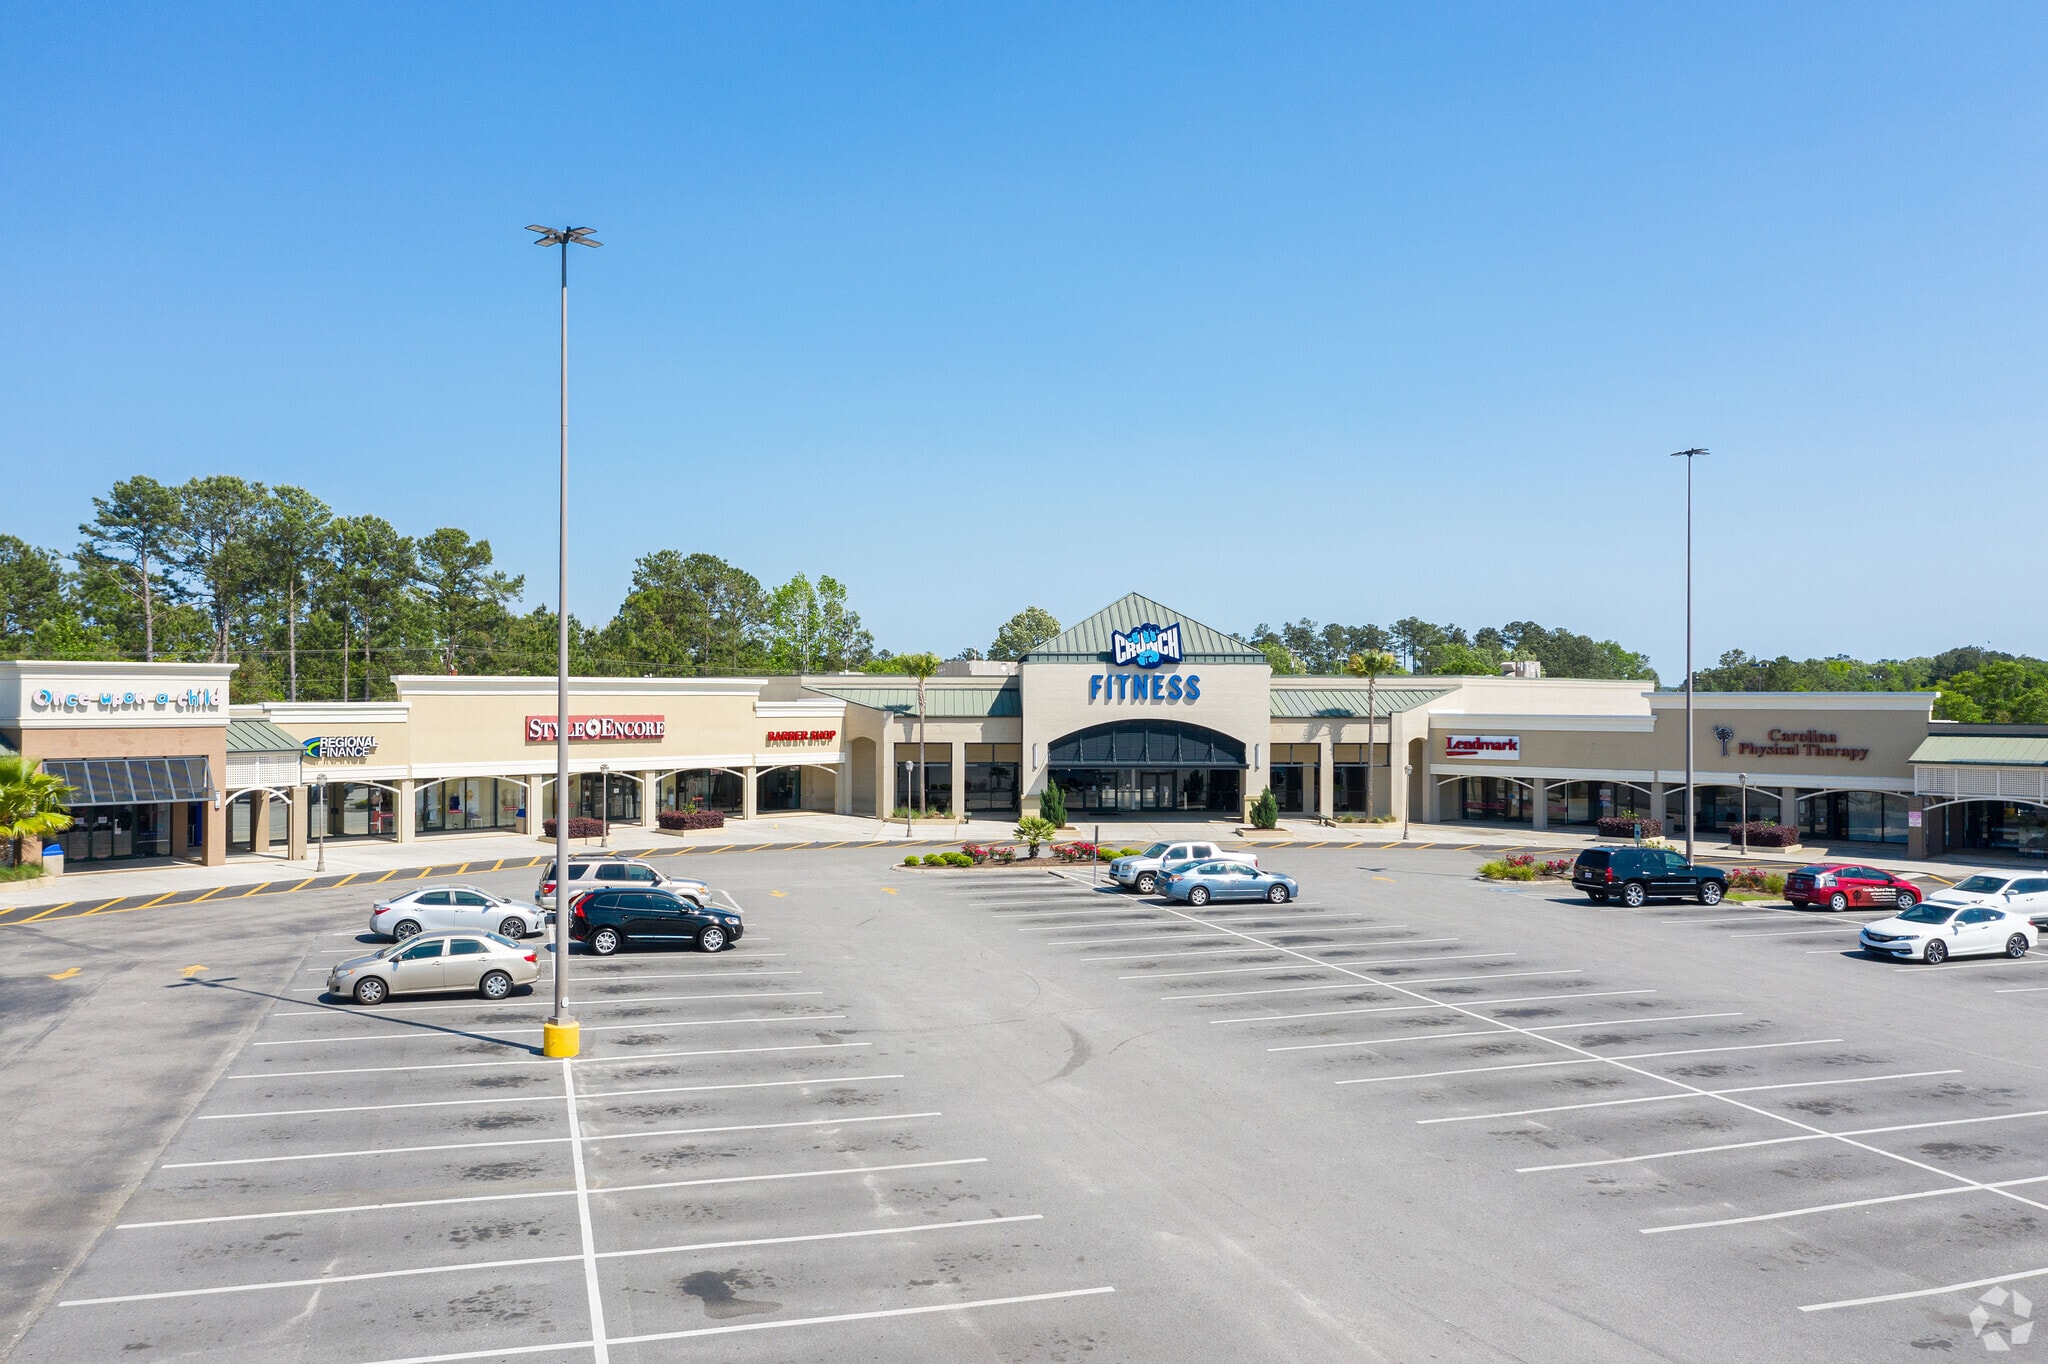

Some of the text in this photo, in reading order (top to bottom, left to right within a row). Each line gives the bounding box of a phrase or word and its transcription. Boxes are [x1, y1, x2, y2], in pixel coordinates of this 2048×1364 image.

[1114, 627, 1180, 664] CRUNCH
[1091, 674, 1201, 700] FITNESS
[33, 688, 222, 708] Once upon a child
[600, 718, 665, 736] ENCORE
[320, 736, 379, 747] REGIONAL
[768, 730, 837, 742] BARBER SHOP
[1446, 736, 1518, 751] Lendmark
[1767, 728, 1837, 743] Carolina
[320, 747, 370, 758] FINANCE
[1738, 742, 1869, 761] Physical Therapy
